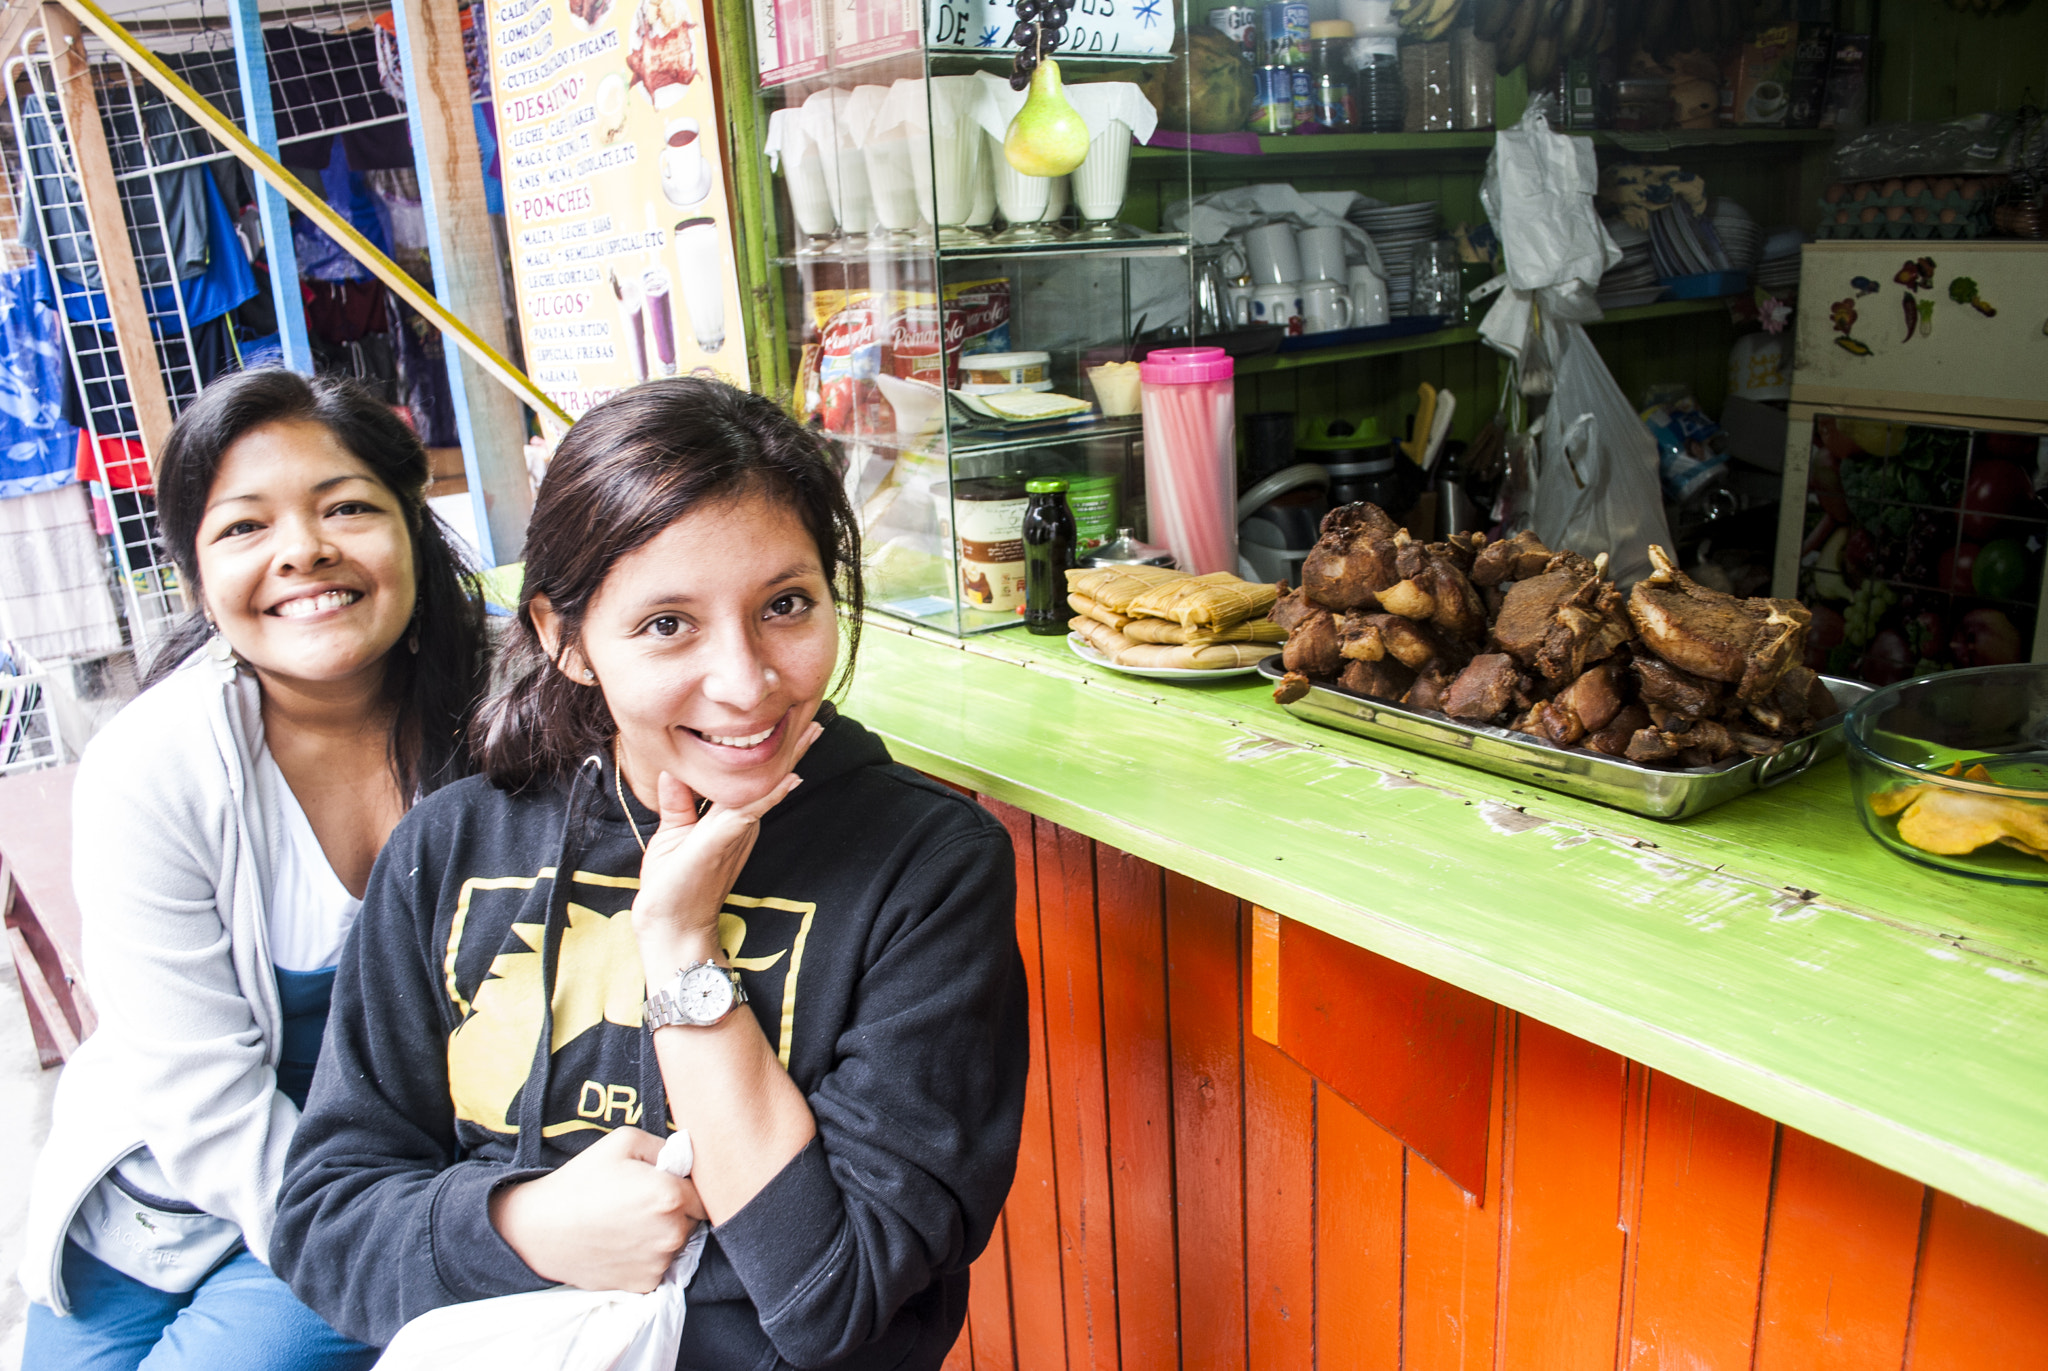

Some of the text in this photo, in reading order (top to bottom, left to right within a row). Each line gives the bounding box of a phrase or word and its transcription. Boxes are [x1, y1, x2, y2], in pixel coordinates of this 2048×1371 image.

[502, 24, 528, 44] LOMO
[936, 5, 969, 45] DE
[578, 29, 619, 59] PICANTE
[504, 46, 532, 67] LOMO
[513, 127, 545, 147] LECHE
[523, 186, 592, 220] PONCHES
[528, 267, 601, 289] LECHE CORTADA
[535, 293, 584, 317] JUGOS
[568, 322, 609, 338] SURTIDO
[577, 345, 615, 360] FRESAS
[99, 1217, 181, 1266] LACOSTE
